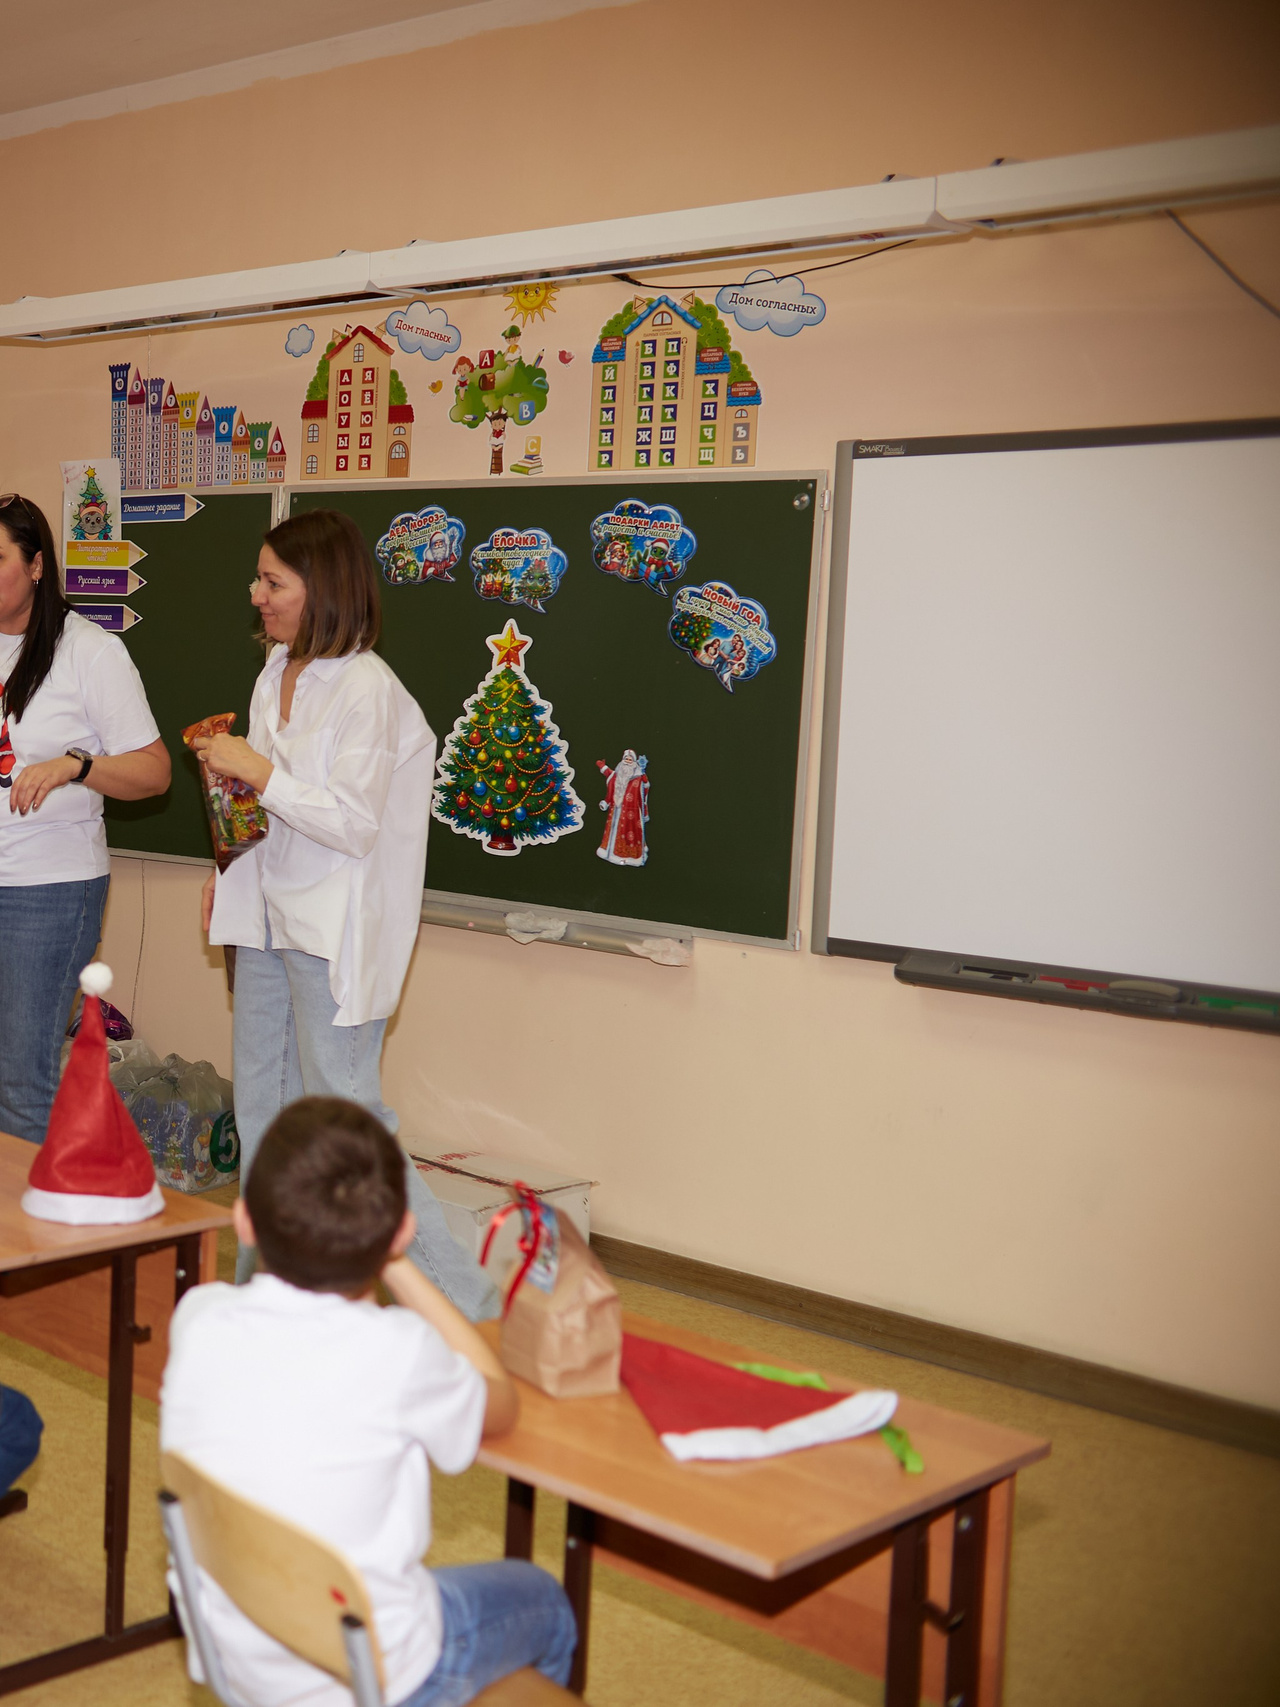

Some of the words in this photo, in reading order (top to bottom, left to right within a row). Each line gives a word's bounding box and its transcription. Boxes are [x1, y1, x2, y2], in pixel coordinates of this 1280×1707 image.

[728, 292, 754, 305] Дом
[755, 298, 817, 315] согласных
[395, 319, 414, 332] Дом
[415, 326, 451, 343] гласных
[644, 343, 653, 355] Б
[667, 341, 678, 353] П
[482, 353, 491, 366] A
[604, 366, 615, 380] Й
[643, 365, 652, 377] В
[666, 362, 677, 375] Ф
[341, 372, 350, 383] А
[364, 370, 372, 381] Я
[603, 388, 614, 400] Л
[642, 387, 650, 398] Г
[665, 385, 675, 397] К
[705, 383, 715, 395] Х
[341, 393, 349, 404] О
[363, 391, 371, 404] Ё
[522, 404, 531, 417] B
[602, 410, 613, 422] М
[640, 407, 650, 421] Д
[664, 407, 674, 419] Т
[703, 404, 715, 418] Ц
[340, 415, 348, 426] У
[361, 414, 371, 425] Ю
[601, 432, 612, 443] Н
[637, 430, 651, 442] Ж
[661, 429, 675, 441] Ш
[703, 427, 713, 439] Ч
[736, 426, 747, 438] Ъ
[338, 436, 348, 447] Ы
[361, 435, 370, 446] И
[528, 439, 537, 453] C
[699, 448, 714, 463] Щ
[735, 448, 745, 461] Ь
[859, 444, 885, 454] SMART
[338, 458, 346, 468] Э
[361, 457, 368, 468] Е
[600, 453, 610, 465] Р
[639, 452, 647, 464] З
[662, 451, 671, 463] С
[123, 504, 155, 513] Домашнее
[155, 503, 181, 515] задание
[389, 525, 408, 538] ДЕД
[410, 513, 445, 530] МОРОЗ-
[610, 516, 650, 527] ПОДАРКИ
[652, 521, 680, 531] ДАРЯТ
[602, 525, 637, 535] радость
[638, 528, 645, 536] и
[645, 529, 682, 540] счастье!
[494, 534, 537, 547] ЁЛОЧКА
[75, 543, 119, 556] Литературное
[477, 549, 504, 558] символ
[505, 548, 552, 560] новогоднего
[502, 558, 524, 569] чуда!
[77, 575, 100, 588] Русский
[101, 578, 115, 588] язык
[703, 588, 741, 612] НОВЫЙ
[741, 606, 761, 625] ГОД
[78, 613, 112, 621] ематика
